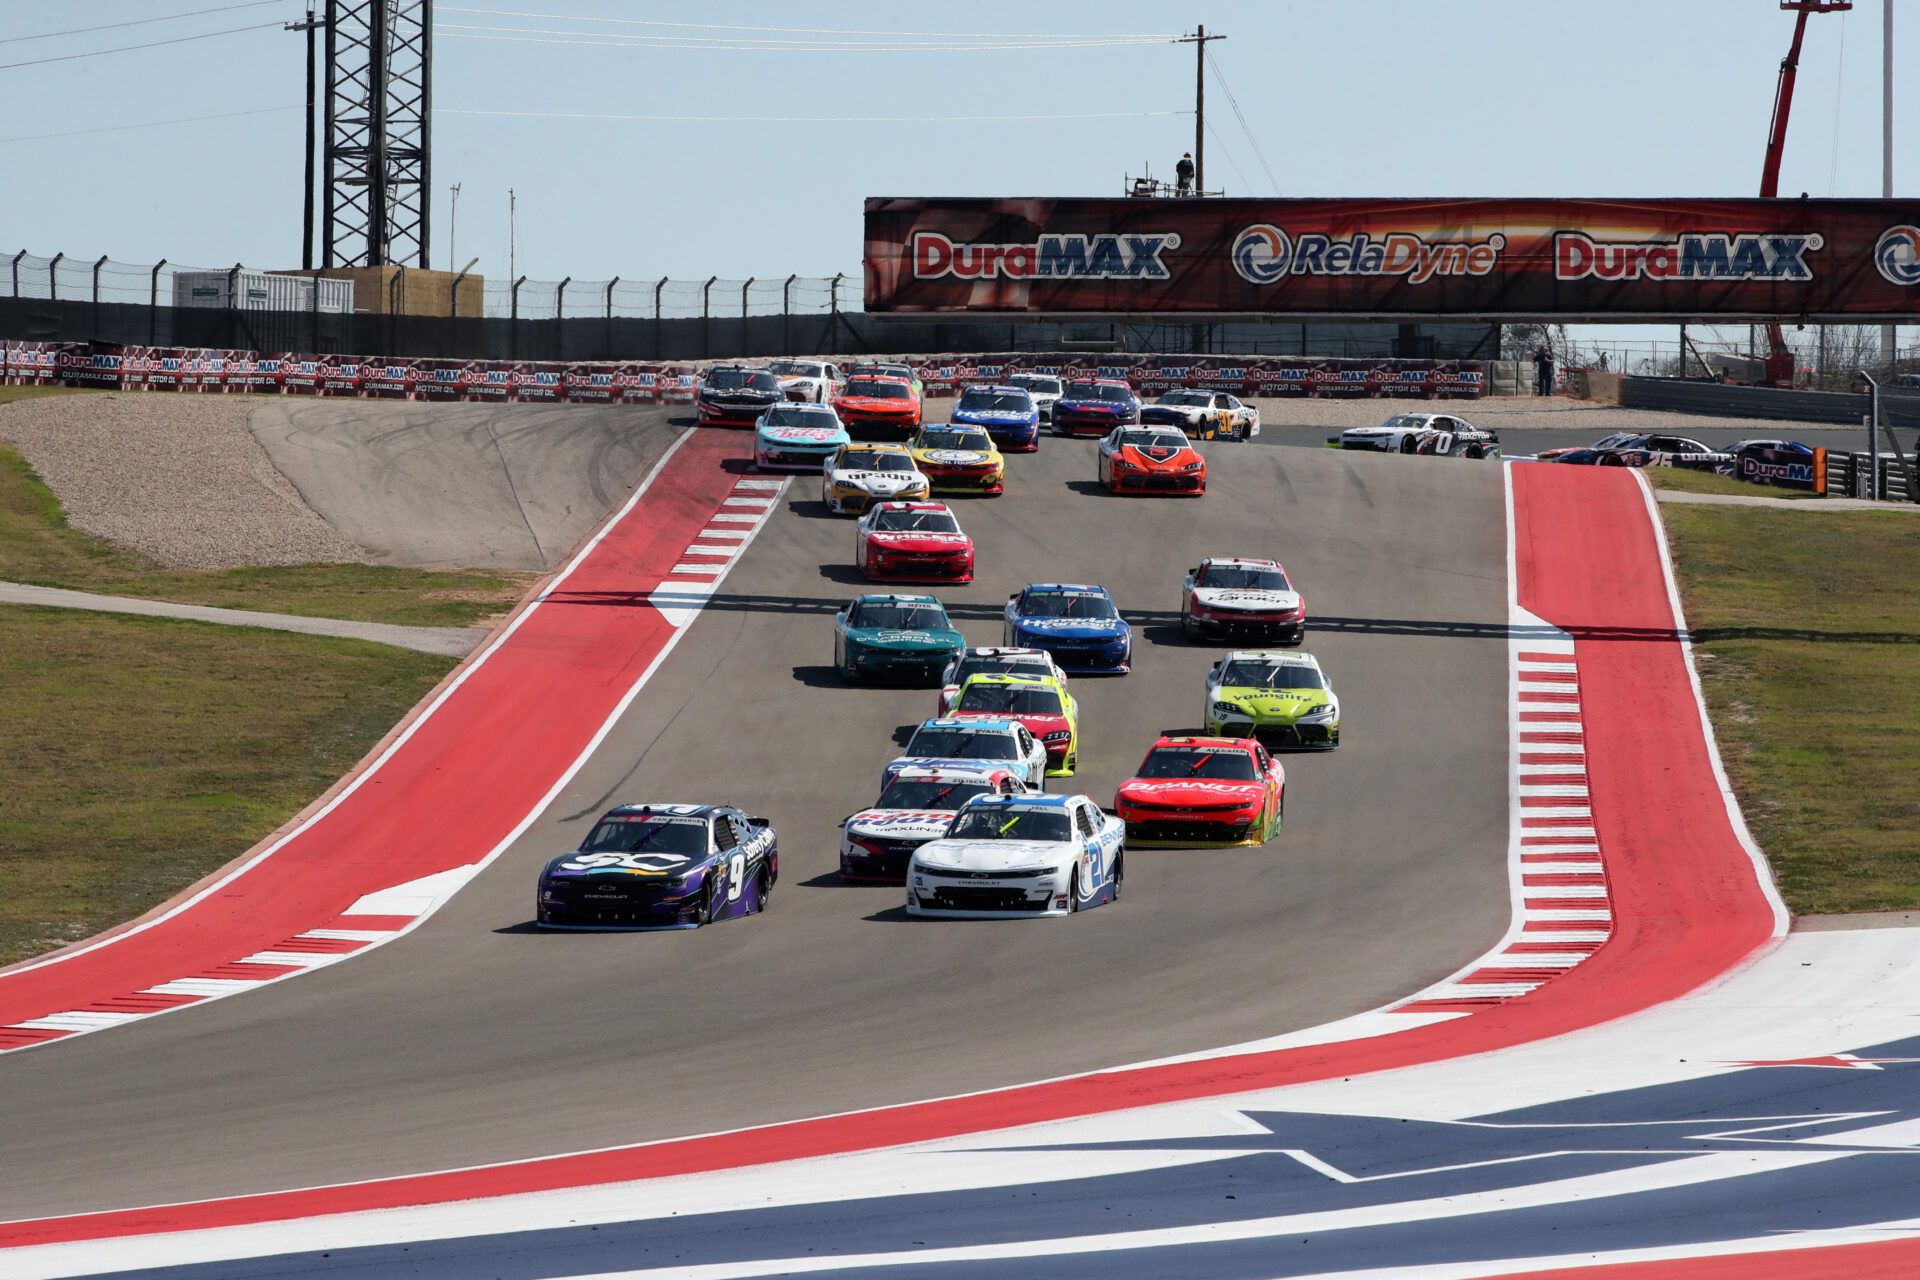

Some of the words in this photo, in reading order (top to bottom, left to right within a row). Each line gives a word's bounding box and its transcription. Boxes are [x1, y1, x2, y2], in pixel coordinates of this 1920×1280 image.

[60, 352, 122, 369] DuraMAX
[143, 358, 181, 373] DuraMAX
[283, 361, 318, 376] DuraMAX
[320, 364, 359, 379] DuraMAX
[363, 366, 407, 381] DuraMAX
[920, 367, 955, 380] DuraMAX
[958, 366, 1003, 379] DuraMAX
[1067, 366, 1129, 380] DuraMAX
[1135, 367, 1190, 381] DuraMAX
[1194, 368, 1248, 382] DuraMAX
[411, 368, 462, 384] DuraMAX
[465, 371, 508, 386] DuraMAX
[512, 372, 561, 387] DuraMAX
[566, 374, 614, 387] DuraMAX
[617, 372, 659, 387] DuraMAX
[1253, 369, 1309, 383] DuraMAX
[1314, 370, 1370, 384] DuraMAX
[1374, 371, 1430, 384] DuraMAX
[1433, 371, 1483, 385] DuraMAX
[1141, 382, 1168, 390] MOTOR
[1259, 384, 1286, 392] MOTOR
[1289, 384, 1302, 392] OIL
[1381, 386, 1408, 394] MOTOR
[1410, 386, 1422, 394] OIL
[872, 533, 967, 542] WHELEN
[1088, 841, 1105, 889] 21
[728, 853, 745, 902] 9
[543, 891, 552, 900] 9
